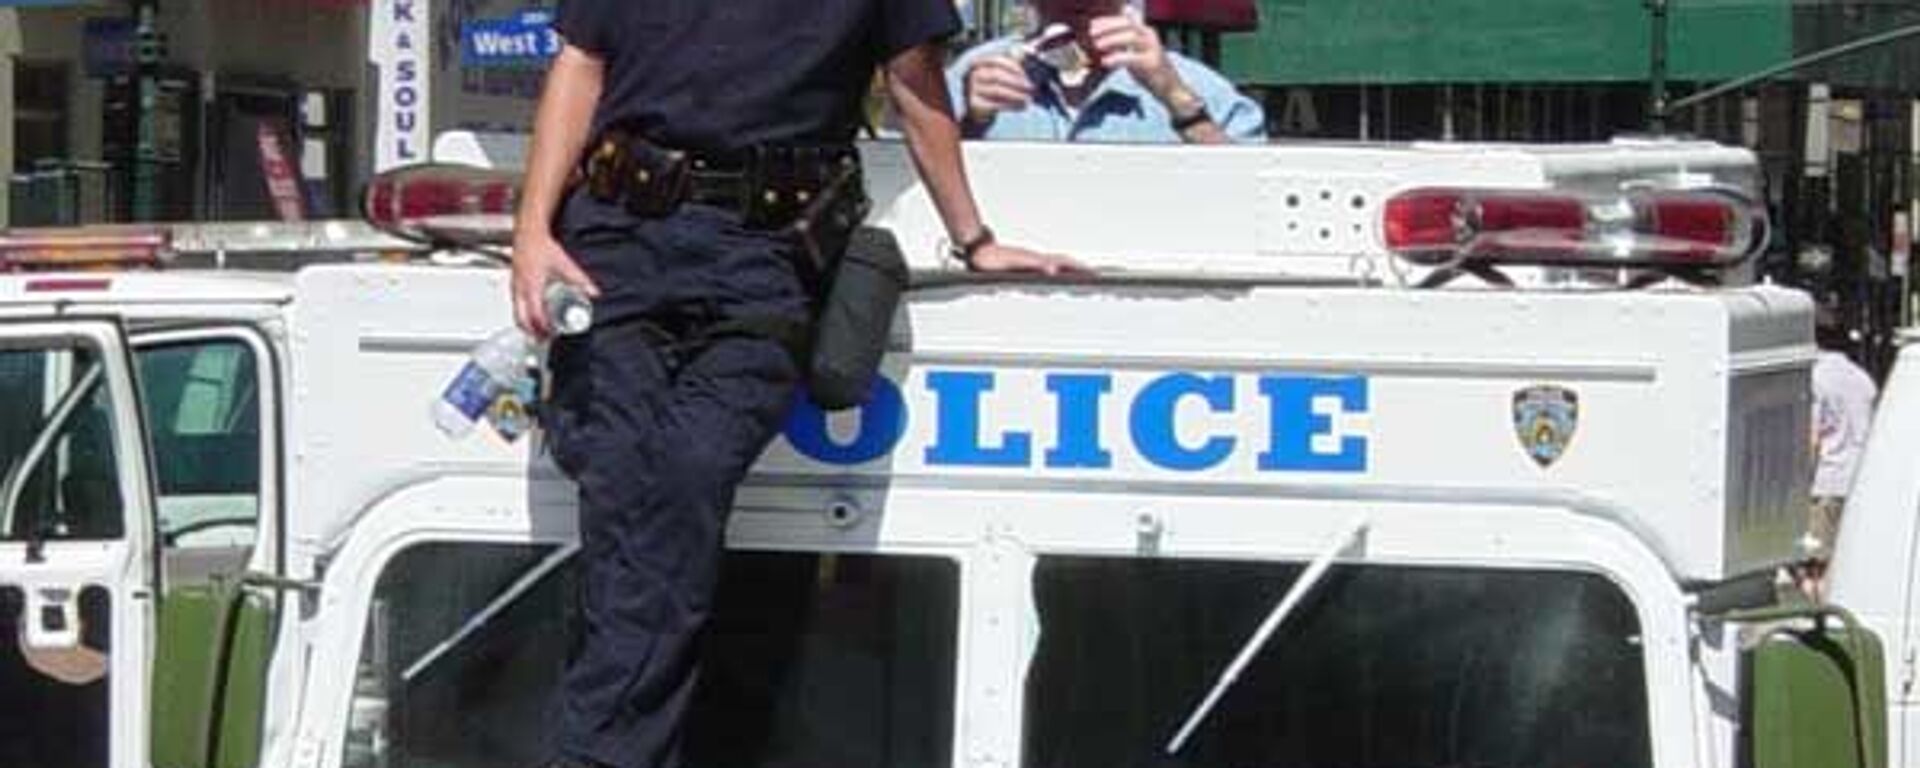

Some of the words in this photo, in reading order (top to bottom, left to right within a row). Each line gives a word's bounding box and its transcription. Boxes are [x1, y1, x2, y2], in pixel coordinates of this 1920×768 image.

[473, 31, 537, 55] West
[394, 61, 417, 159] SOUL
[782, 371, 1368, 472] OLICE
